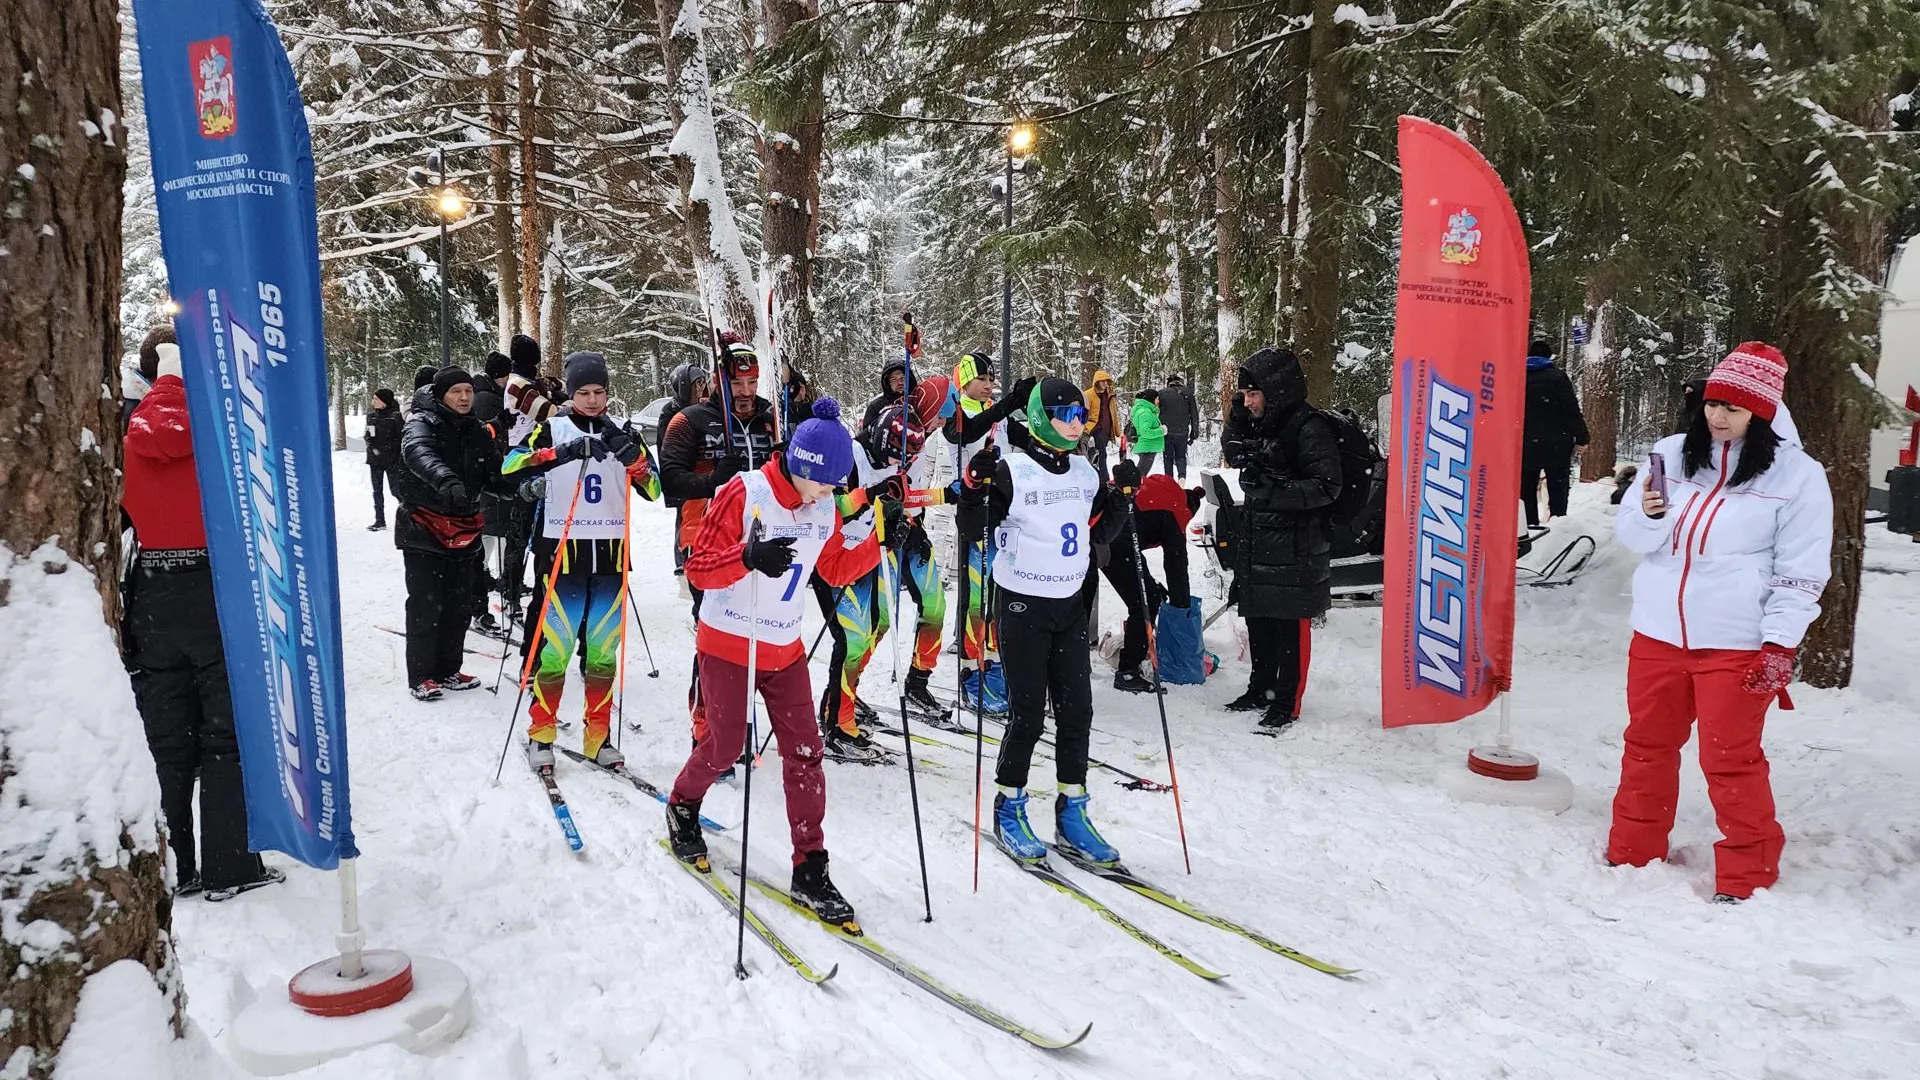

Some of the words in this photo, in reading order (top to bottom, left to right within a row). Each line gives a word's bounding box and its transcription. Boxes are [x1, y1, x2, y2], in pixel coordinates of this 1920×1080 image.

[247, 168, 256, 180] И
[207, 288, 233, 390] резерва
[258, 281, 288, 368] 1965
[1480, 361, 1495, 413] 1965
[520, 416, 526, 425] 2
[793, 446, 825, 466] LUKOIL
[224, 397, 257, 573] олимпийского
[282, 447, 303, 539] Находим
[584, 473, 602, 504] 6
[1473, 464, 1487, 520] Находим
[293, 544, 304, 558] и
[1000, 532, 1007, 548] 8
[1060, 522, 1078, 557] 8
[780, 564, 803, 602] 7
[1013, 568, 1074, 583] МОСКОВСКАЯ
[251, 579, 268, 653] школа
[295, 563, 316, 648] Таланты
[306, 653, 331, 775] Спортивные
[318, 780, 336, 841] Ищем
